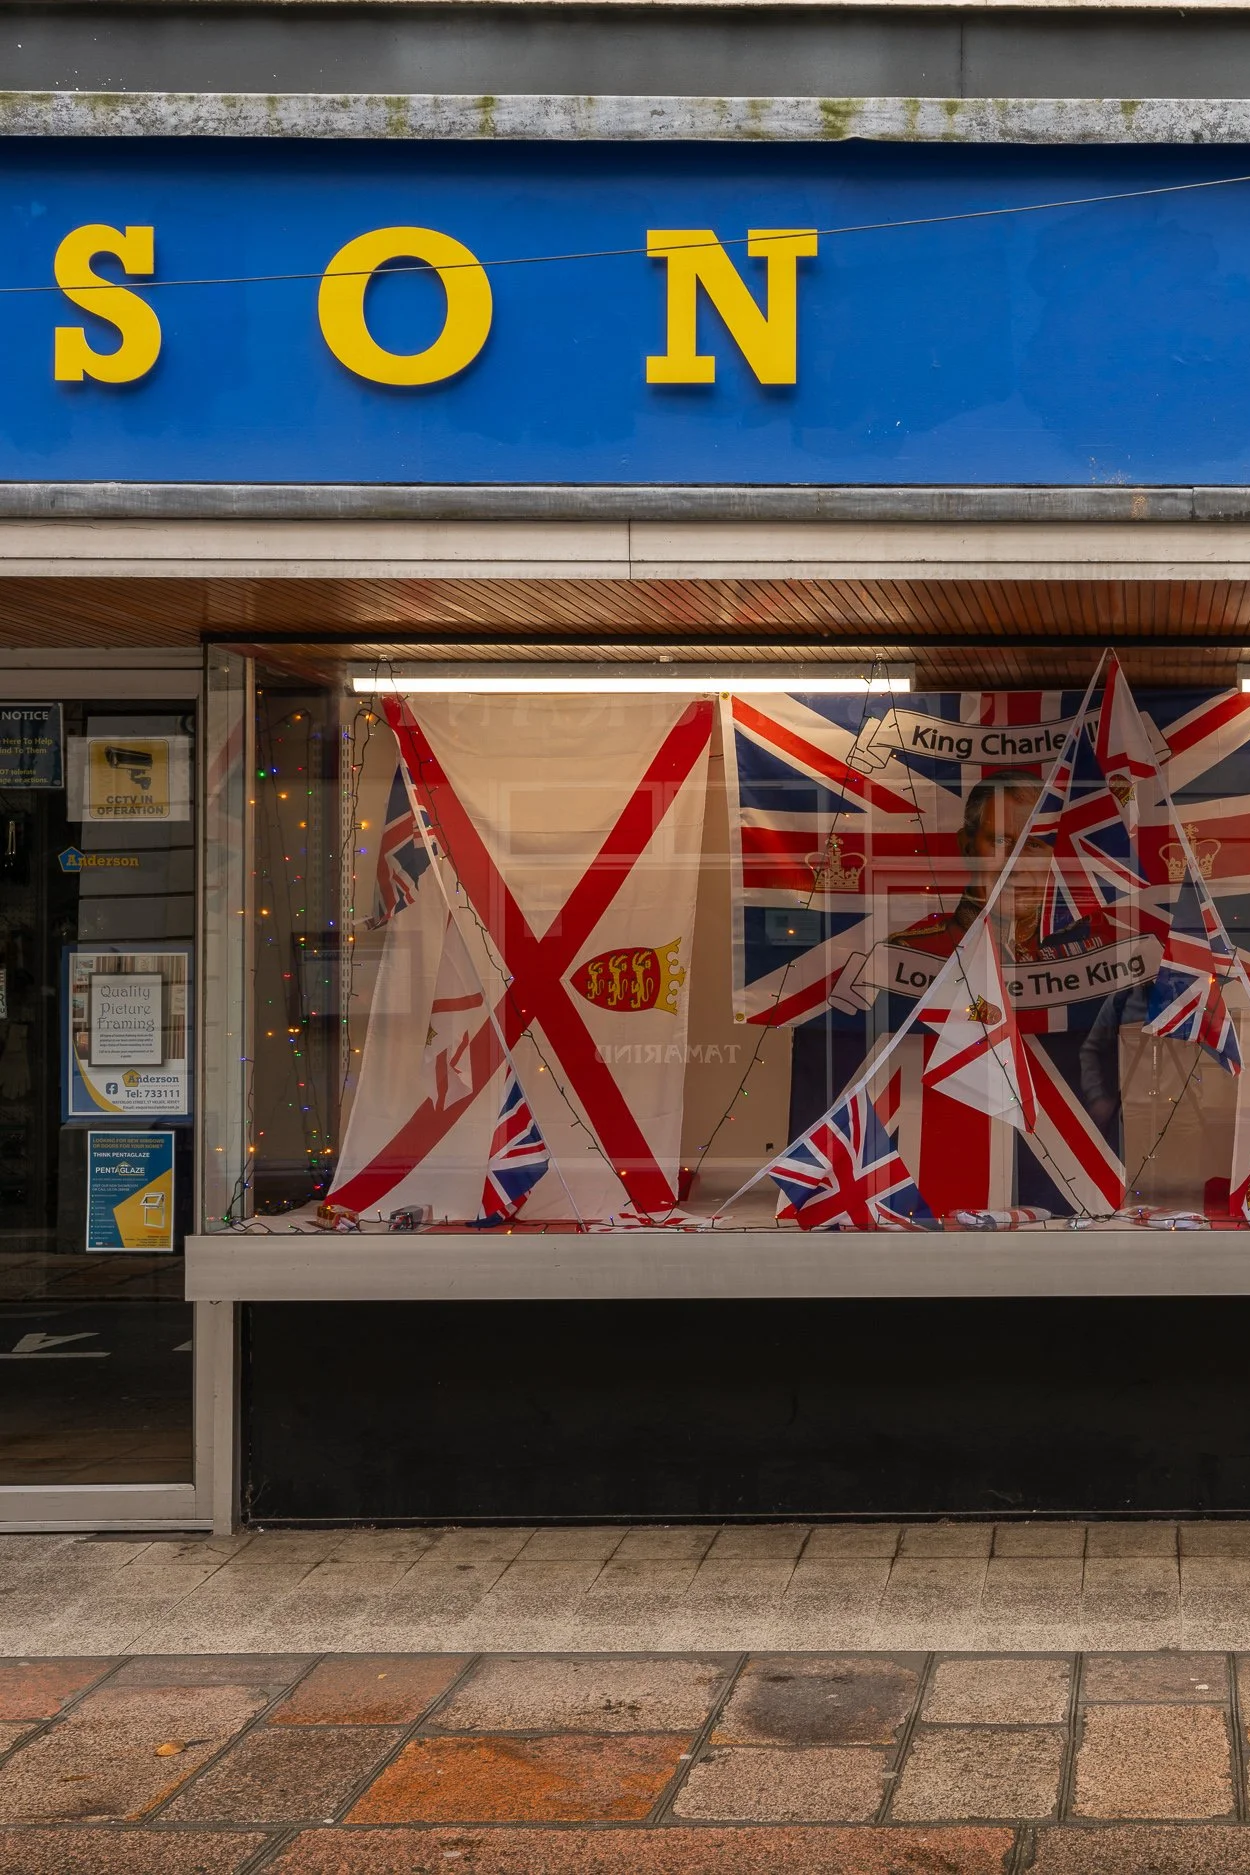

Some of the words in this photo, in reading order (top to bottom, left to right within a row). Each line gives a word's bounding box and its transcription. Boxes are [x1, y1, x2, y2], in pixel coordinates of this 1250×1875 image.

[1, 711, 49, 720] NOTICE
[34, 737, 53, 747] Help
[911, 725, 973, 759] King
[980, 728, 1067, 756] Charle
[26, 746, 48, 754] Them
[106, 795, 137, 804] CCTV
[141, 795, 153, 804] IN
[97, 805, 164, 815] OPERATION
[66, 854, 140, 867] Anderson
[895, 962, 938, 988] Lo
[1027, 969, 1080, 995] The
[1085, 953, 1147, 988] King
[100, 984, 151, 1001] Quality
[99, 1002, 152, 1017] Picture
[97, 1017, 155, 1032] Framing
[128, 1075, 179, 1083] Anderson
[125, 1089, 142, 1098] Tel:
[144, 1089, 180, 1098] 733111
[95, 1166, 145, 1174] PENTAGLAZE
